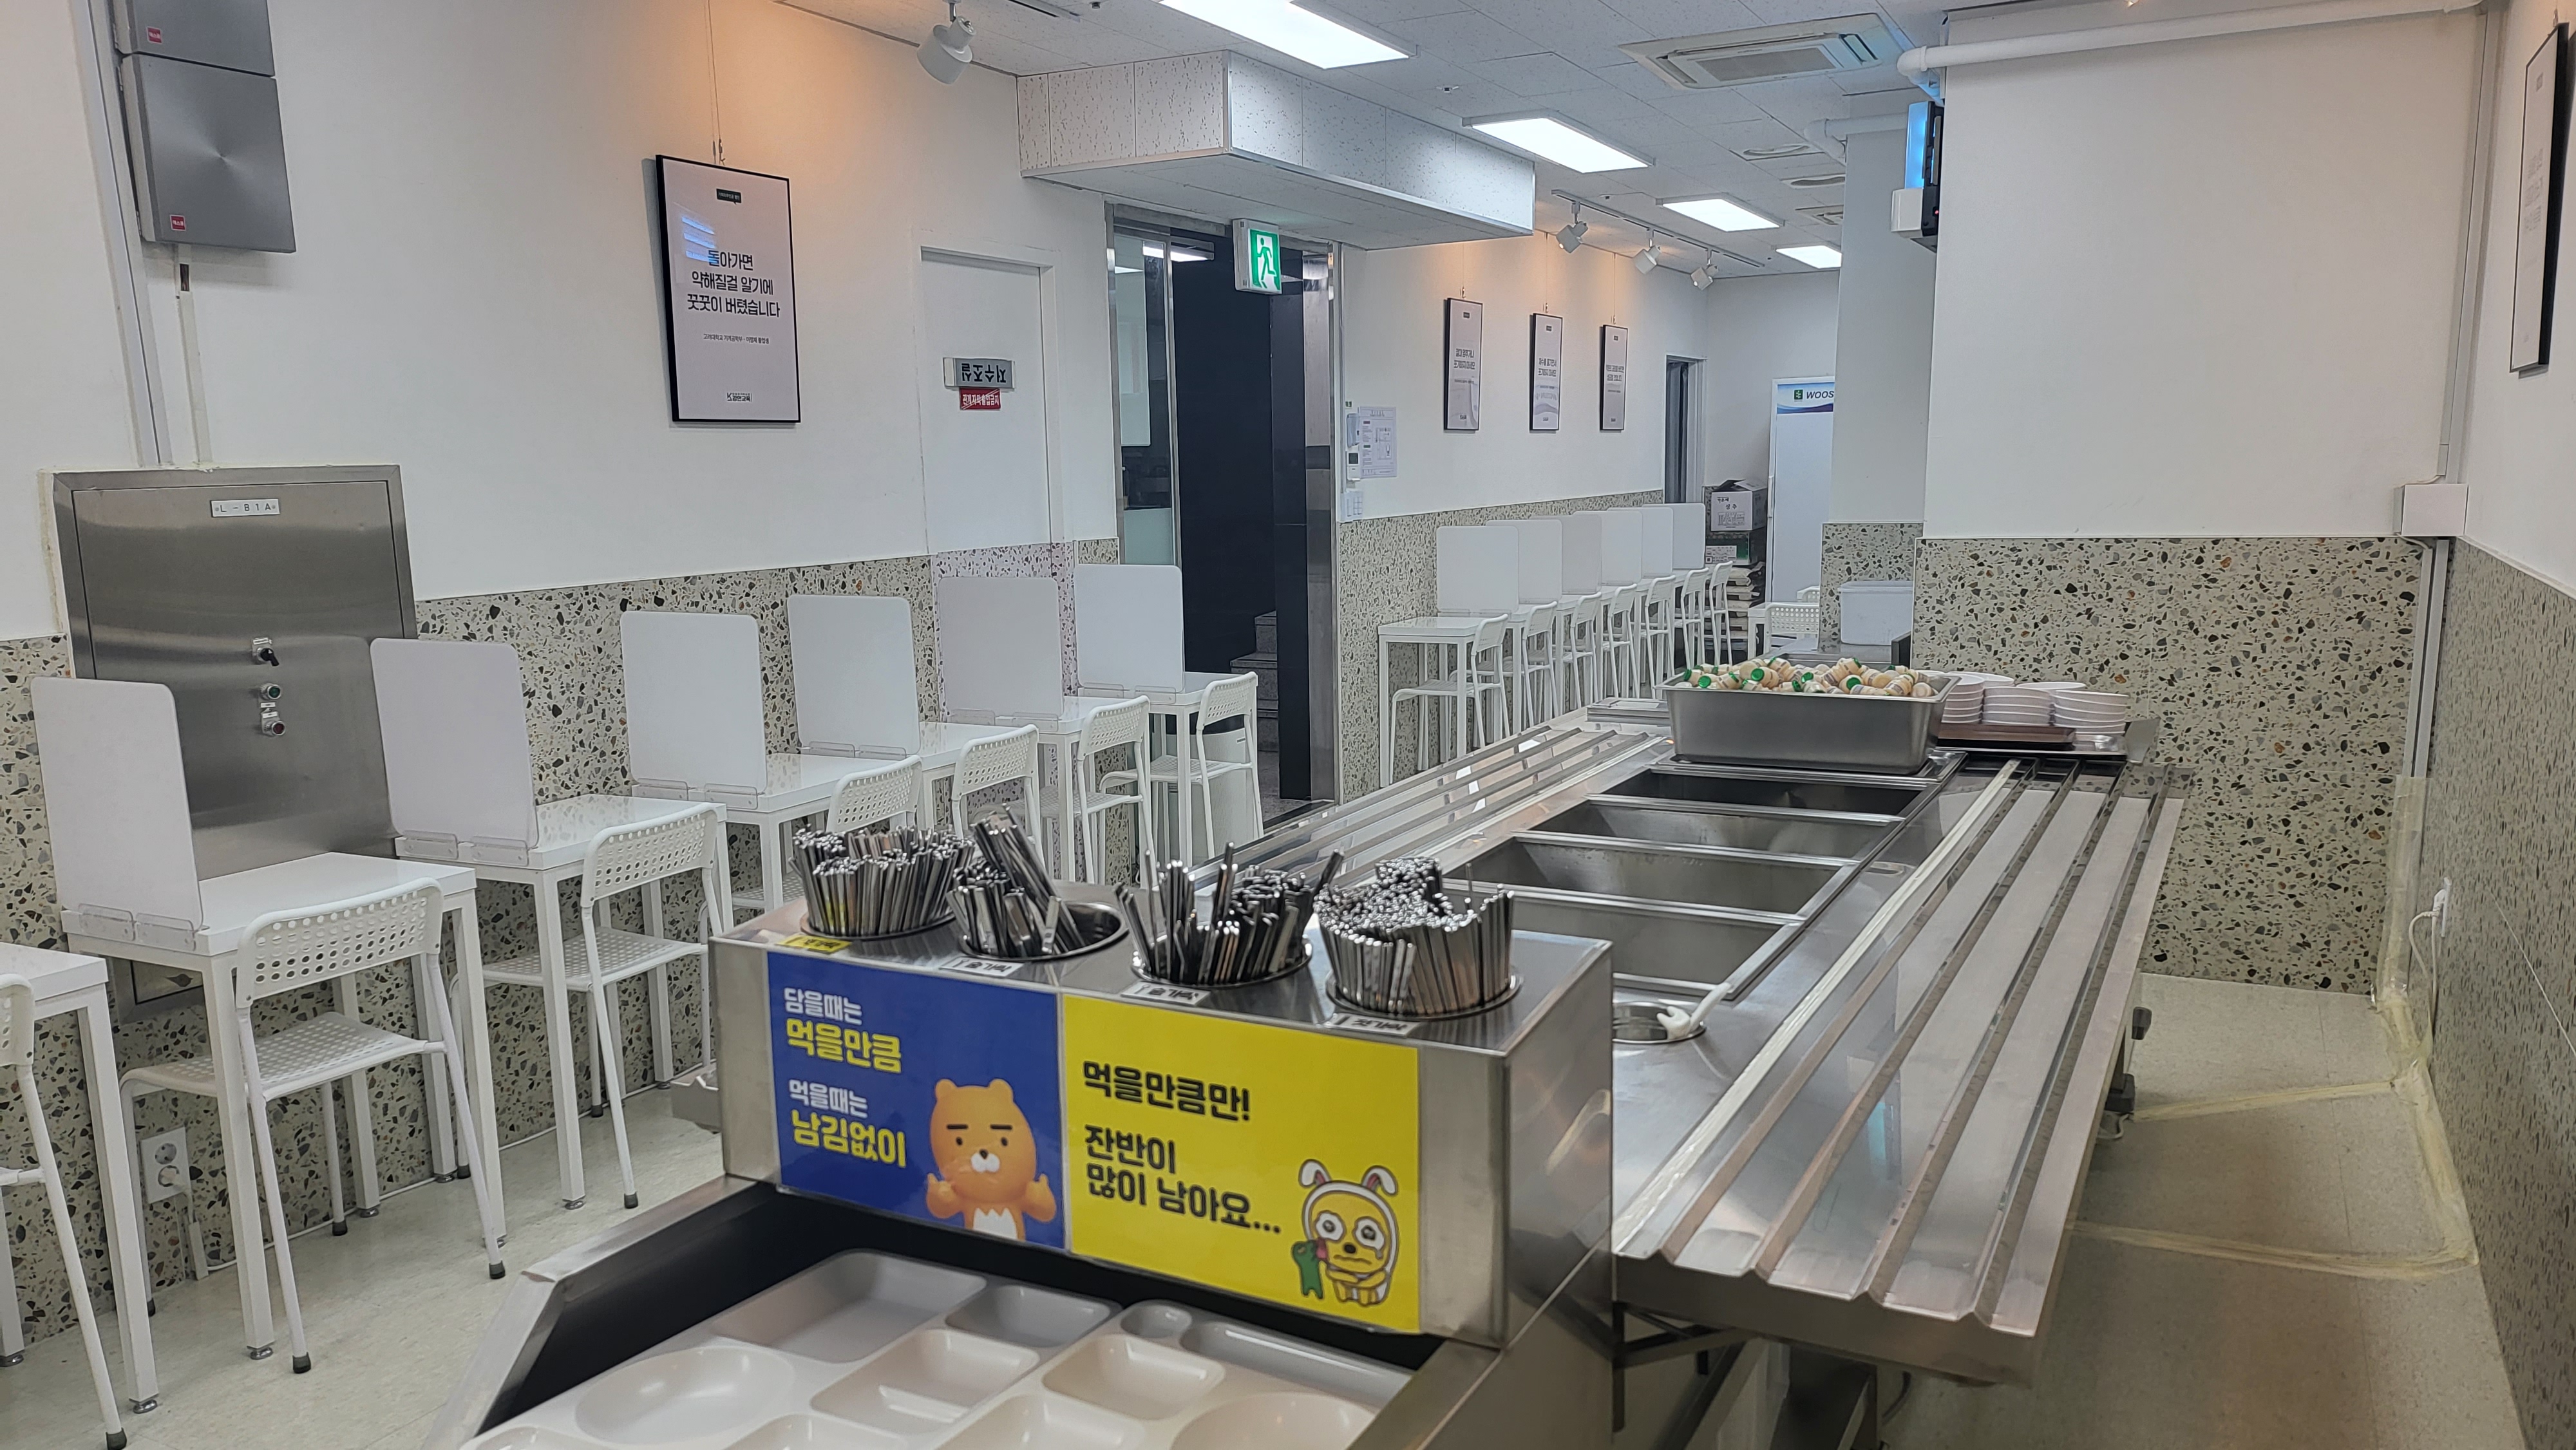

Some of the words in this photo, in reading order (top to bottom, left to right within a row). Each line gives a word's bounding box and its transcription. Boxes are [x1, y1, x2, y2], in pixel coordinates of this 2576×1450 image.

[708, 250, 753, 270] 돌아가면
[692, 271, 738, 292] 약해질걸
[741, 276, 773, 295] 알기에
[687, 294, 722, 313] 꿋꿋이
[725, 297, 781, 317] 버텼습니다
[961, 363, 1007, 383] 저수조실
[1806, 391, 1835, 399] WOOS
[784, 987, 862, 1026] 담을때는
[786, 1018, 902, 1073] 먹을만큼
[789, 1079, 868, 1118] 먹을때는
[1083, 1060, 1249, 1121] 먹을만큼만!
[791, 1109, 906, 1168] 남김없이
[1085, 1124, 1175, 1174] 잔반이
[1087, 1163, 1146, 1206] 많이
[1157, 1176, 1281, 1234] 남아요...
